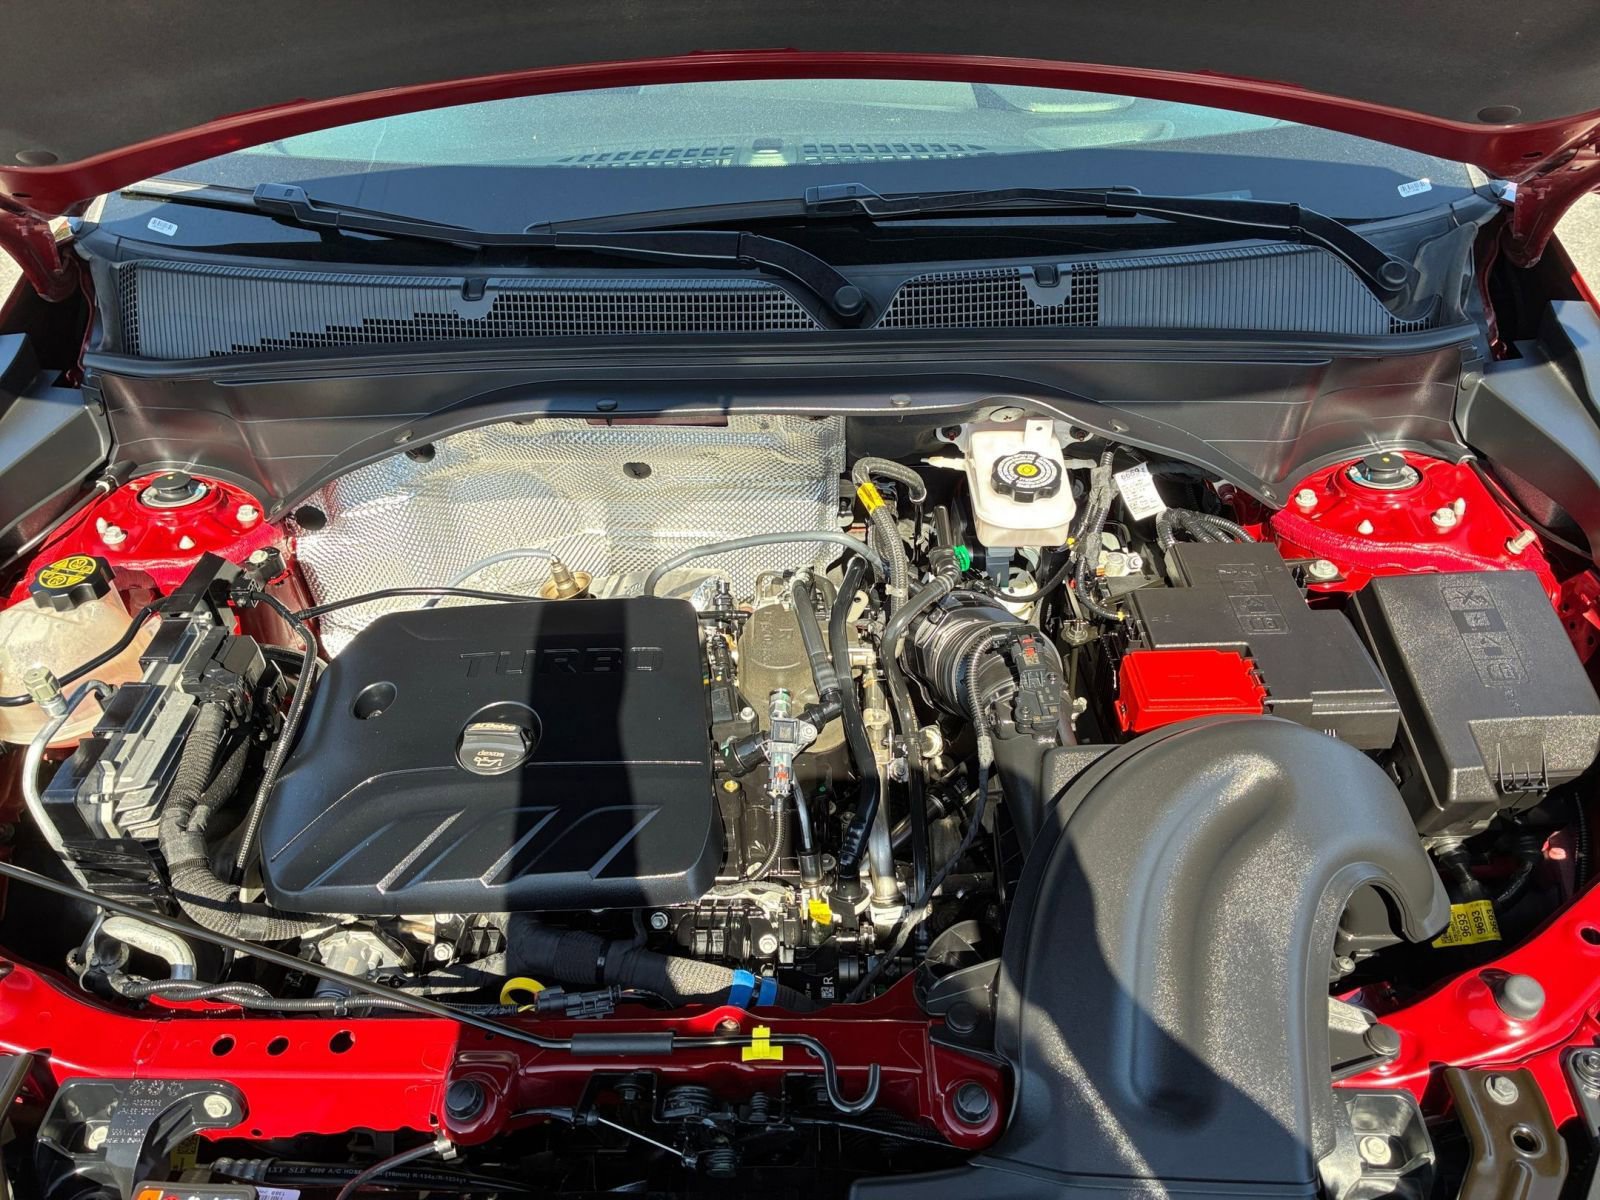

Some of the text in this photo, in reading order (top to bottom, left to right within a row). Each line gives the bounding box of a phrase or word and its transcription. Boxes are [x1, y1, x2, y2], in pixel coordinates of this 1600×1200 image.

[460, 646, 665, 678] TURBO
[1456, 913, 1472, 938] 9693
[1471, 910, 1487, 935] 9693
[822, 976, 834, 985] R
